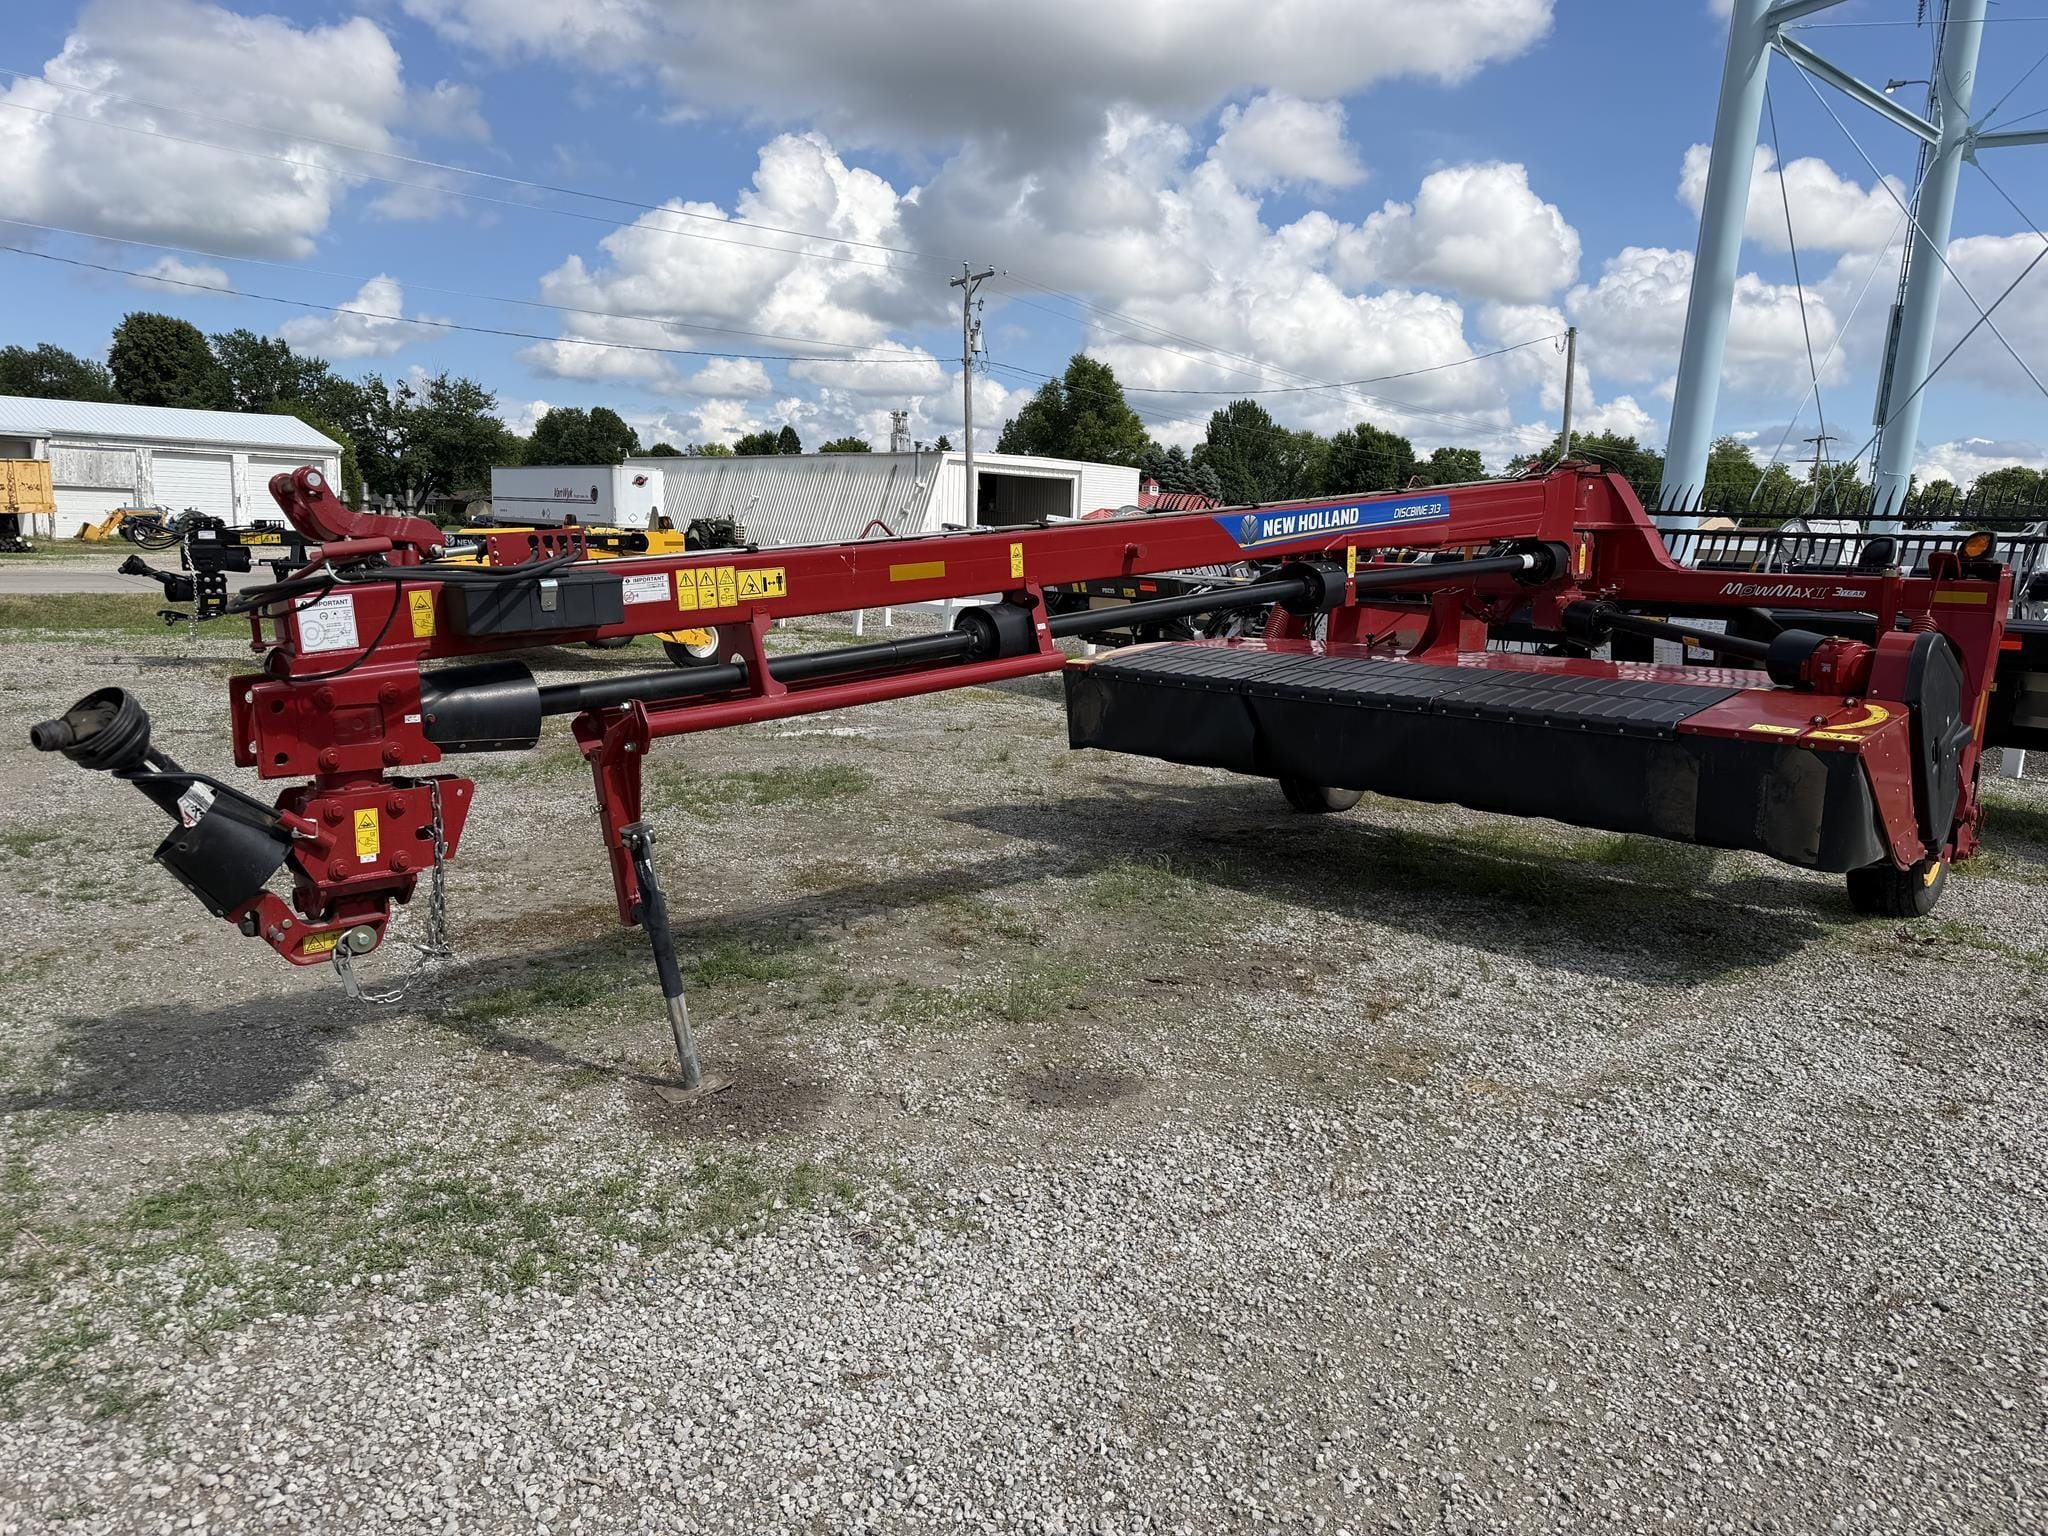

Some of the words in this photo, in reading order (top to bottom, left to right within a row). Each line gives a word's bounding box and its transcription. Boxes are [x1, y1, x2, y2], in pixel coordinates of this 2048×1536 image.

[1393, 505, 1428, 519] DISCBINE
[1428, 503, 1442, 515] 313
[1263, 515, 1297, 538] NEW
[1298, 507, 1359, 532] HOLLAND
[632, 575, 665, 584] IMPORTANT
